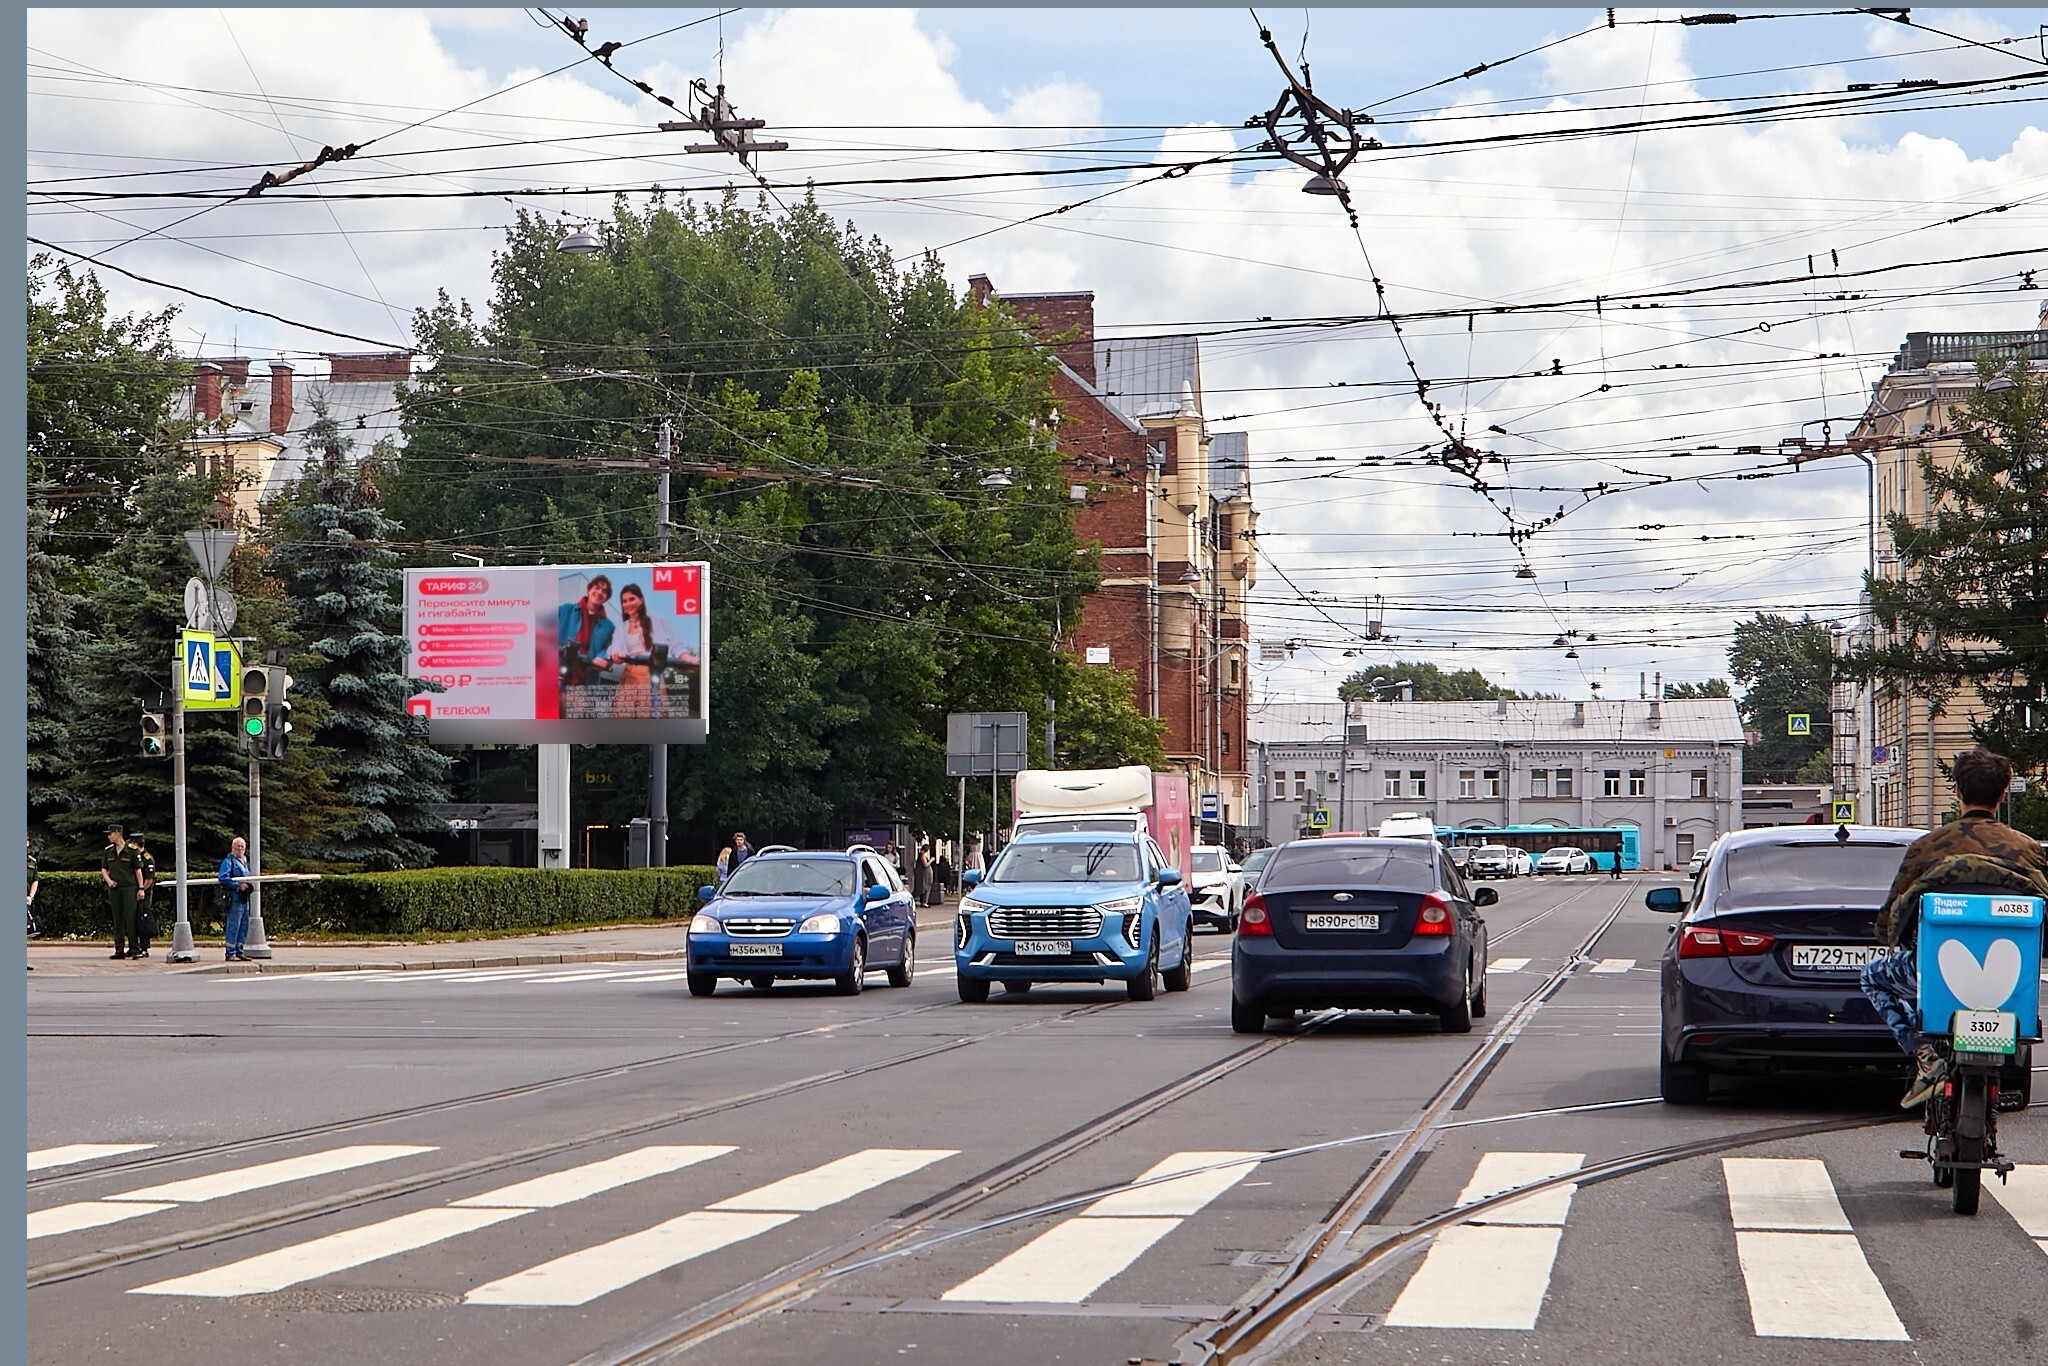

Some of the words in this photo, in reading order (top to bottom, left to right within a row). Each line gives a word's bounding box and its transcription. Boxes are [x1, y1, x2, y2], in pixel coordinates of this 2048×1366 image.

[425, 582, 466, 591] ТАРИФ
[468, 581, 483, 590] 24
[418, 599, 485, 608] Переносите
[487, 598, 531, 608] минуты
[427, 608, 486, 617] гигабайты
[674, 674, 689, 684] 18+
[436, 706, 490, 715] ТЕЛЕКОМ
[1933, 897, 1968, 907] Яндекс
[1933, 907, 1963, 916] Лавка
[1309, 916, 1356, 927] М890РС
[1359, 916, 1376, 925] 178
[1056, 941, 1070, 949] 198
[1797, 948, 1866, 964] М729ТМ
[1970, 1021, 2000, 1032] 3307
